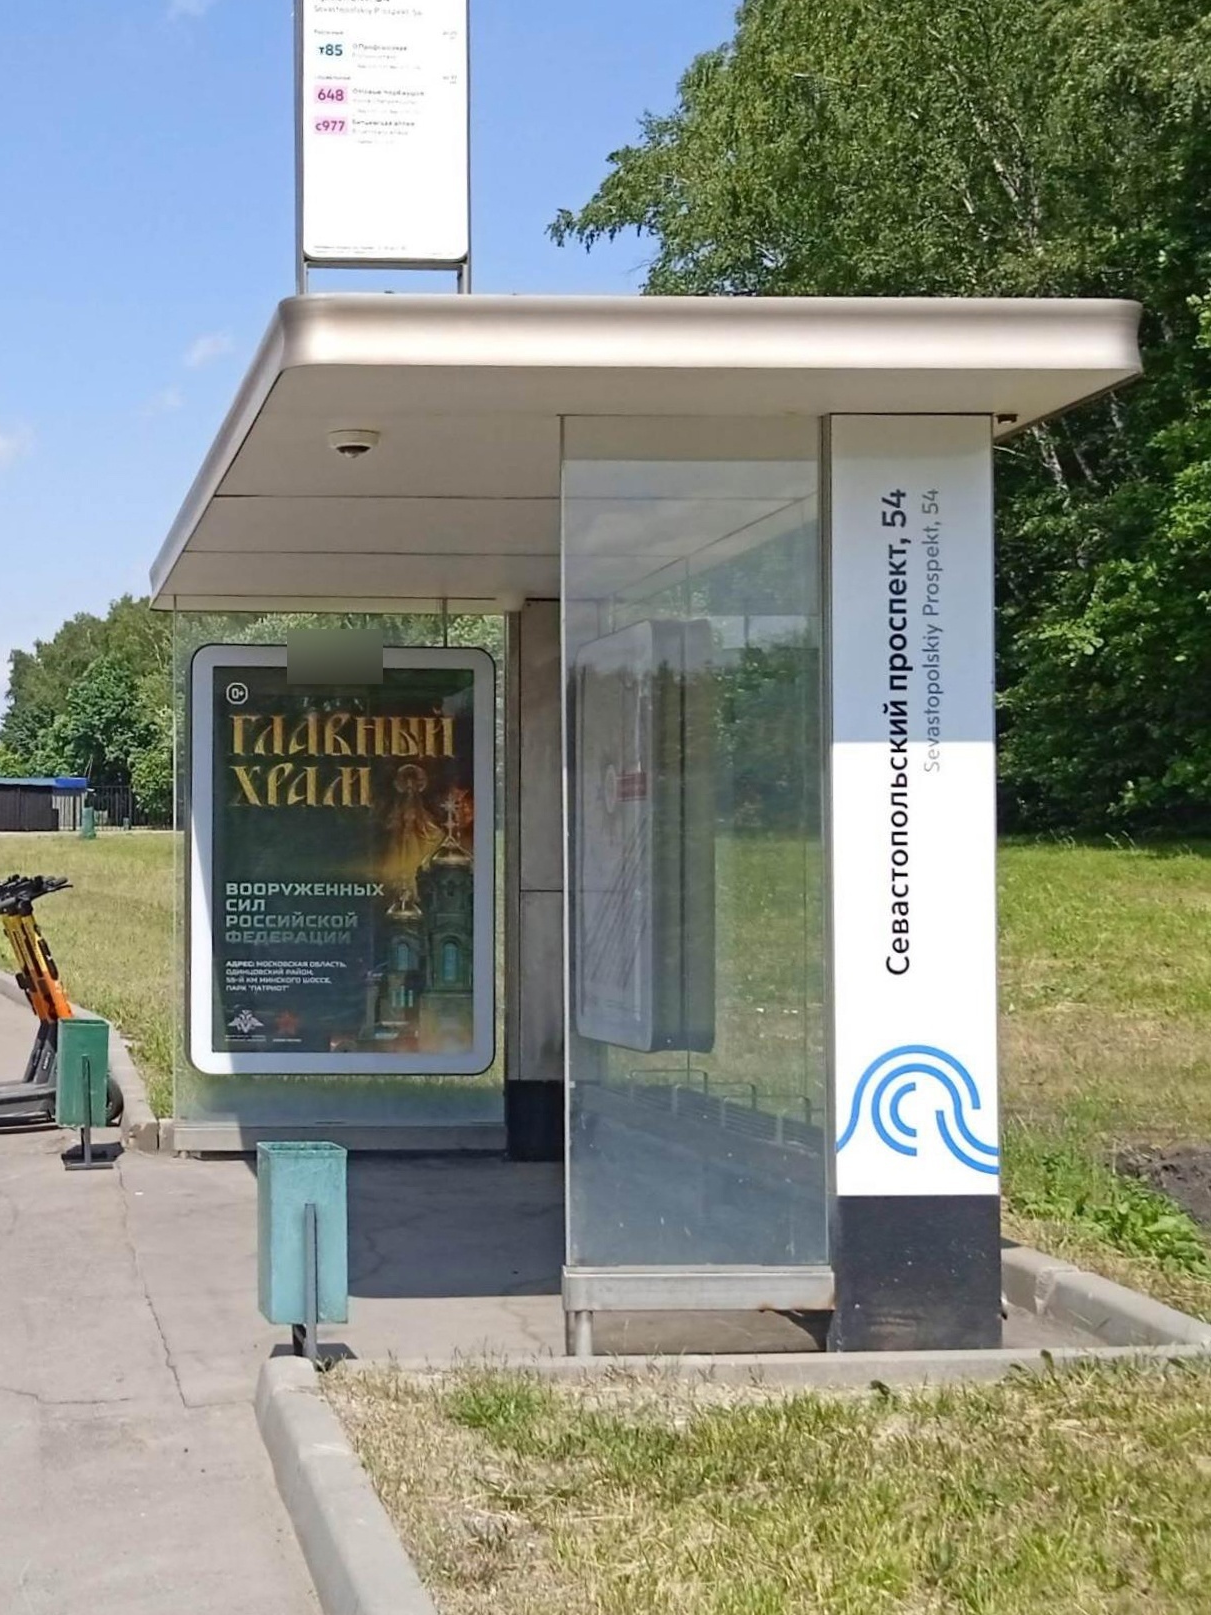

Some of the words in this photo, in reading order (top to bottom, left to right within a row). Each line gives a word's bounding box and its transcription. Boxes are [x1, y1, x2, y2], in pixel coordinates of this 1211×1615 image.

[317, 88, 345, 102] 648
[881, 488, 907, 529] 54
[921, 488, 939, 515] 54
[921, 521, 944, 617] Prospekt,
[888, 537, 913, 692] проспект,
[921, 623, 944, 773] Sevastopolskiy
[229, 763, 374, 808] ХРАМ
[883, 700, 910, 976] Севастопольский
[225, 882, 384, 897] ВООРУЖЕННЫХ
[225, 899, 266, 912] СИЛ
[225, 912, 358, 929] РОССИЙСКОЙ
[225, 930, 352, 946] ФЕДЕРАЦИИ
